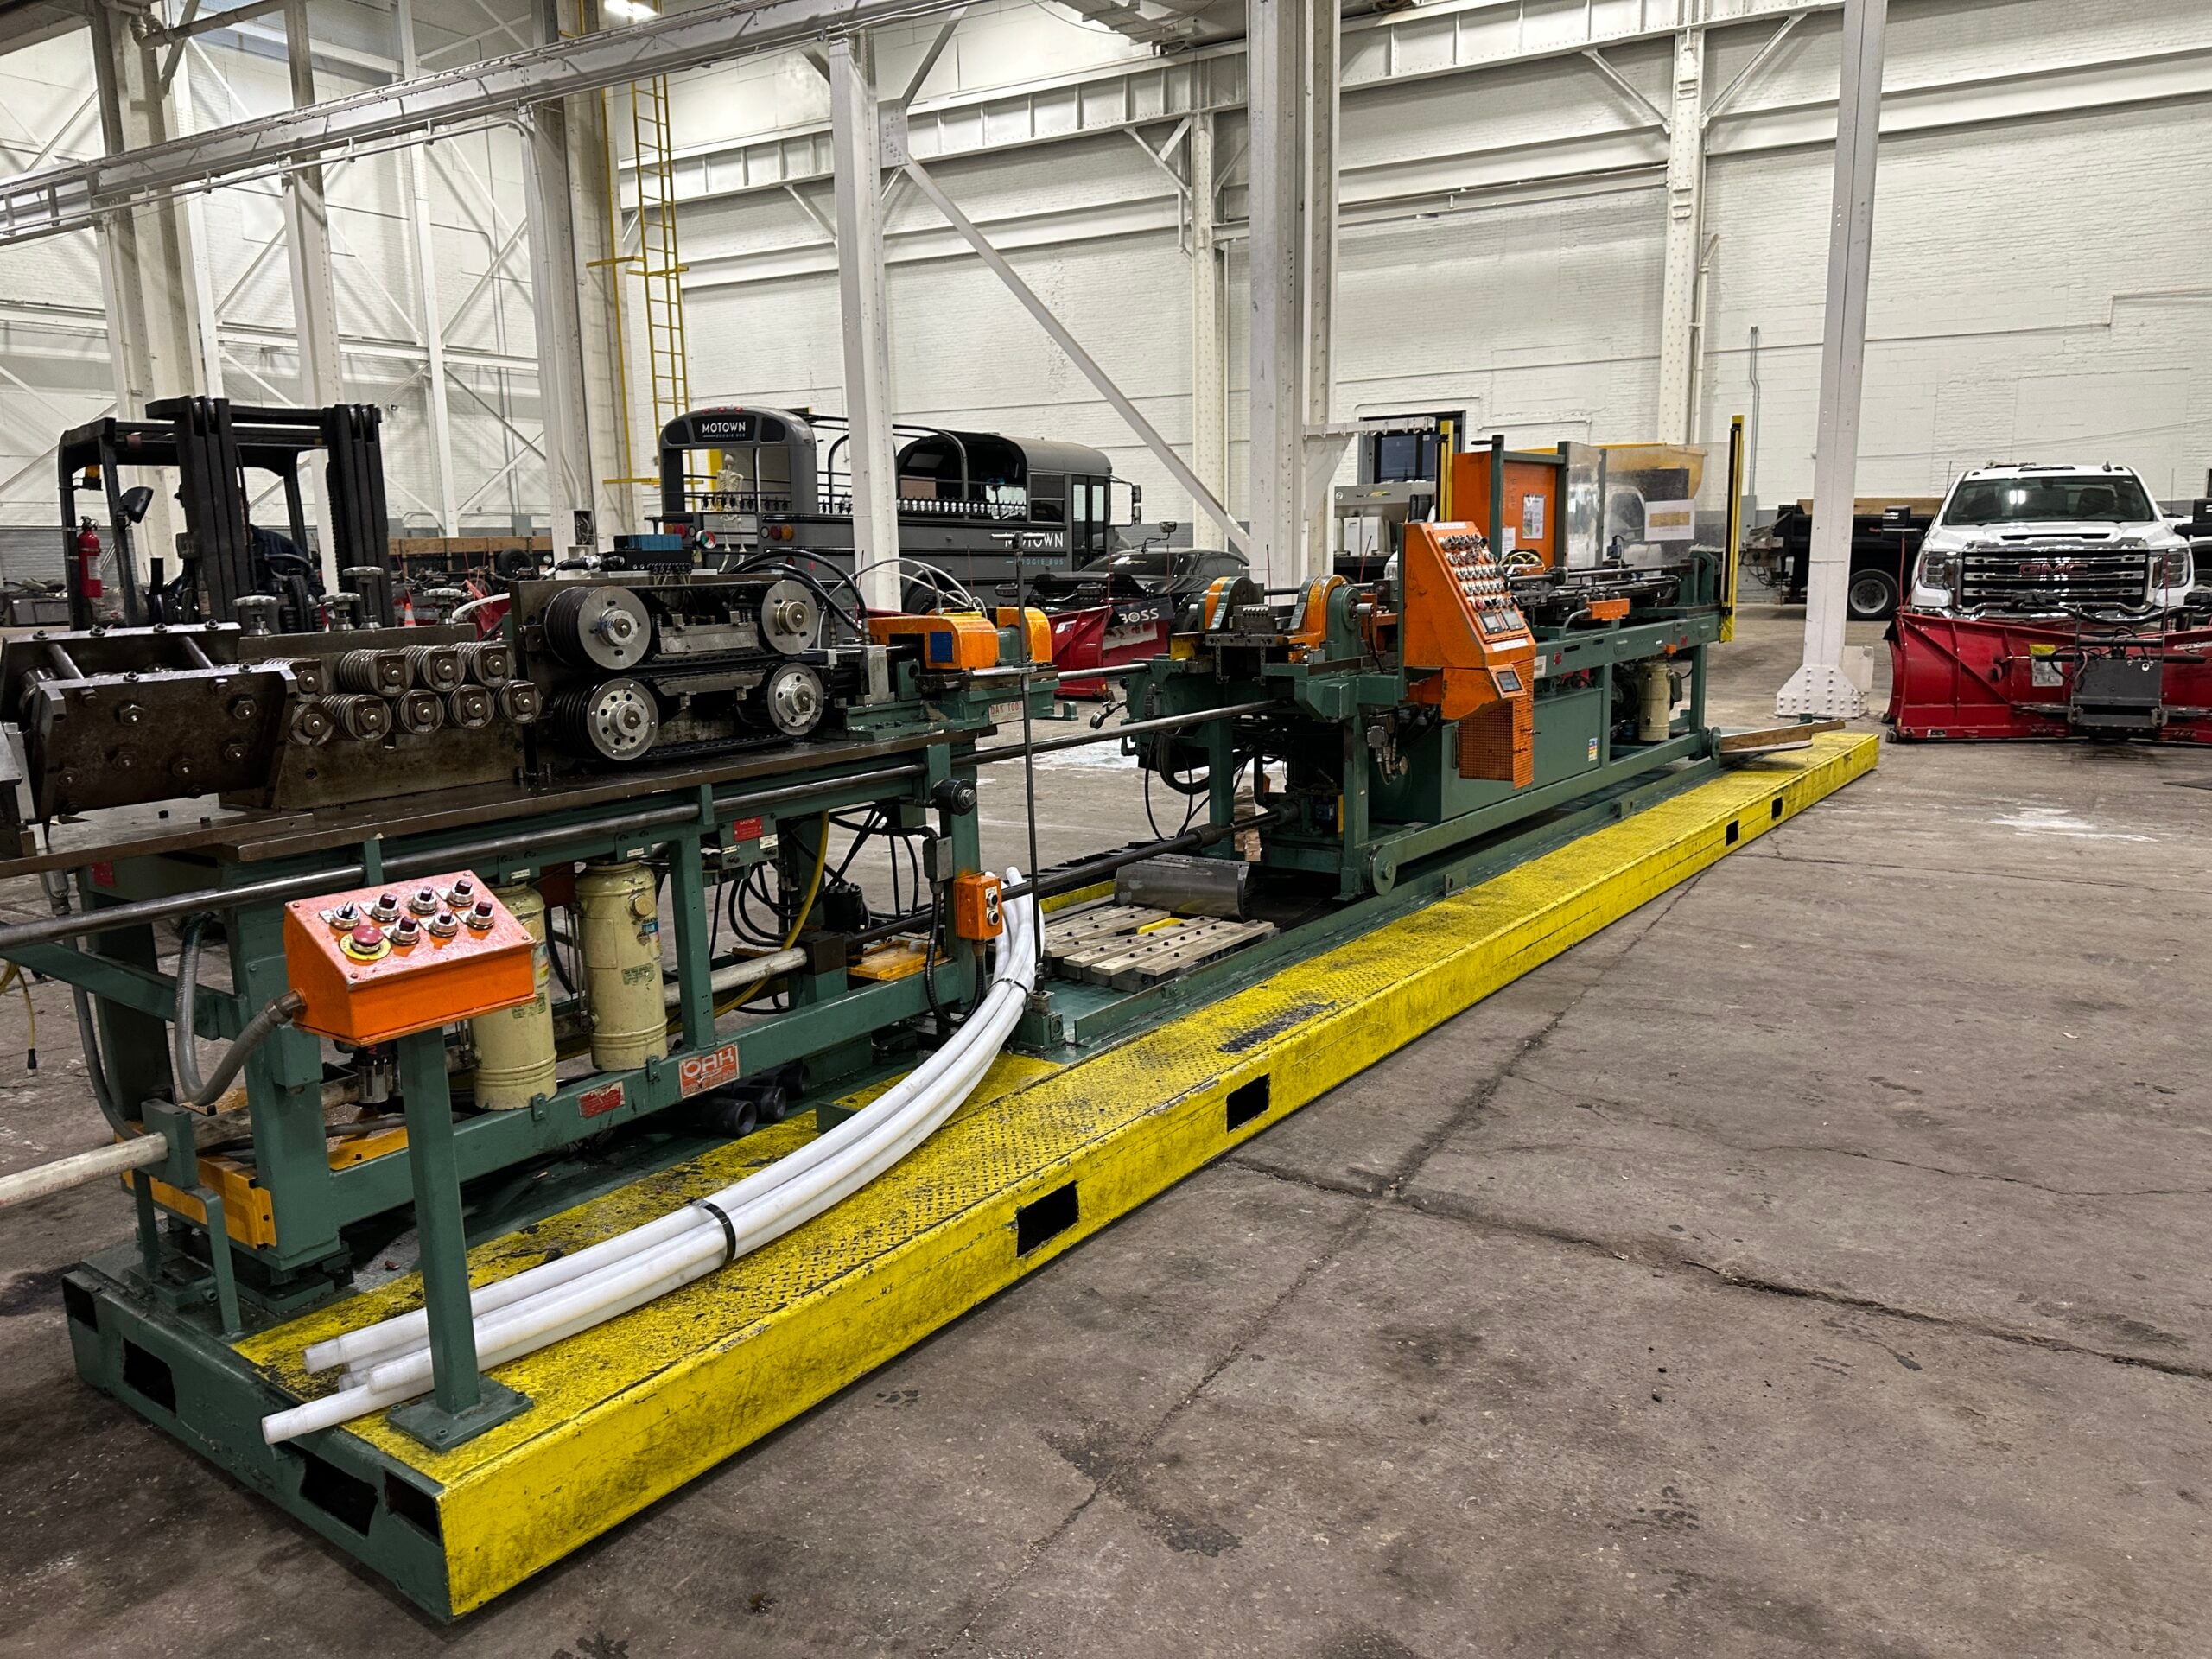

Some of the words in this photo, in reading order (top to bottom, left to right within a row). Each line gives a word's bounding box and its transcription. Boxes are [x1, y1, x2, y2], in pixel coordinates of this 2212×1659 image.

[702, 421, 747, 433] MOTOWN
[1004, 531, 1064, 548] TOWN
[2018, 563, 2088, 575] GMC
[683, 1047, 734, 1078] OAK
